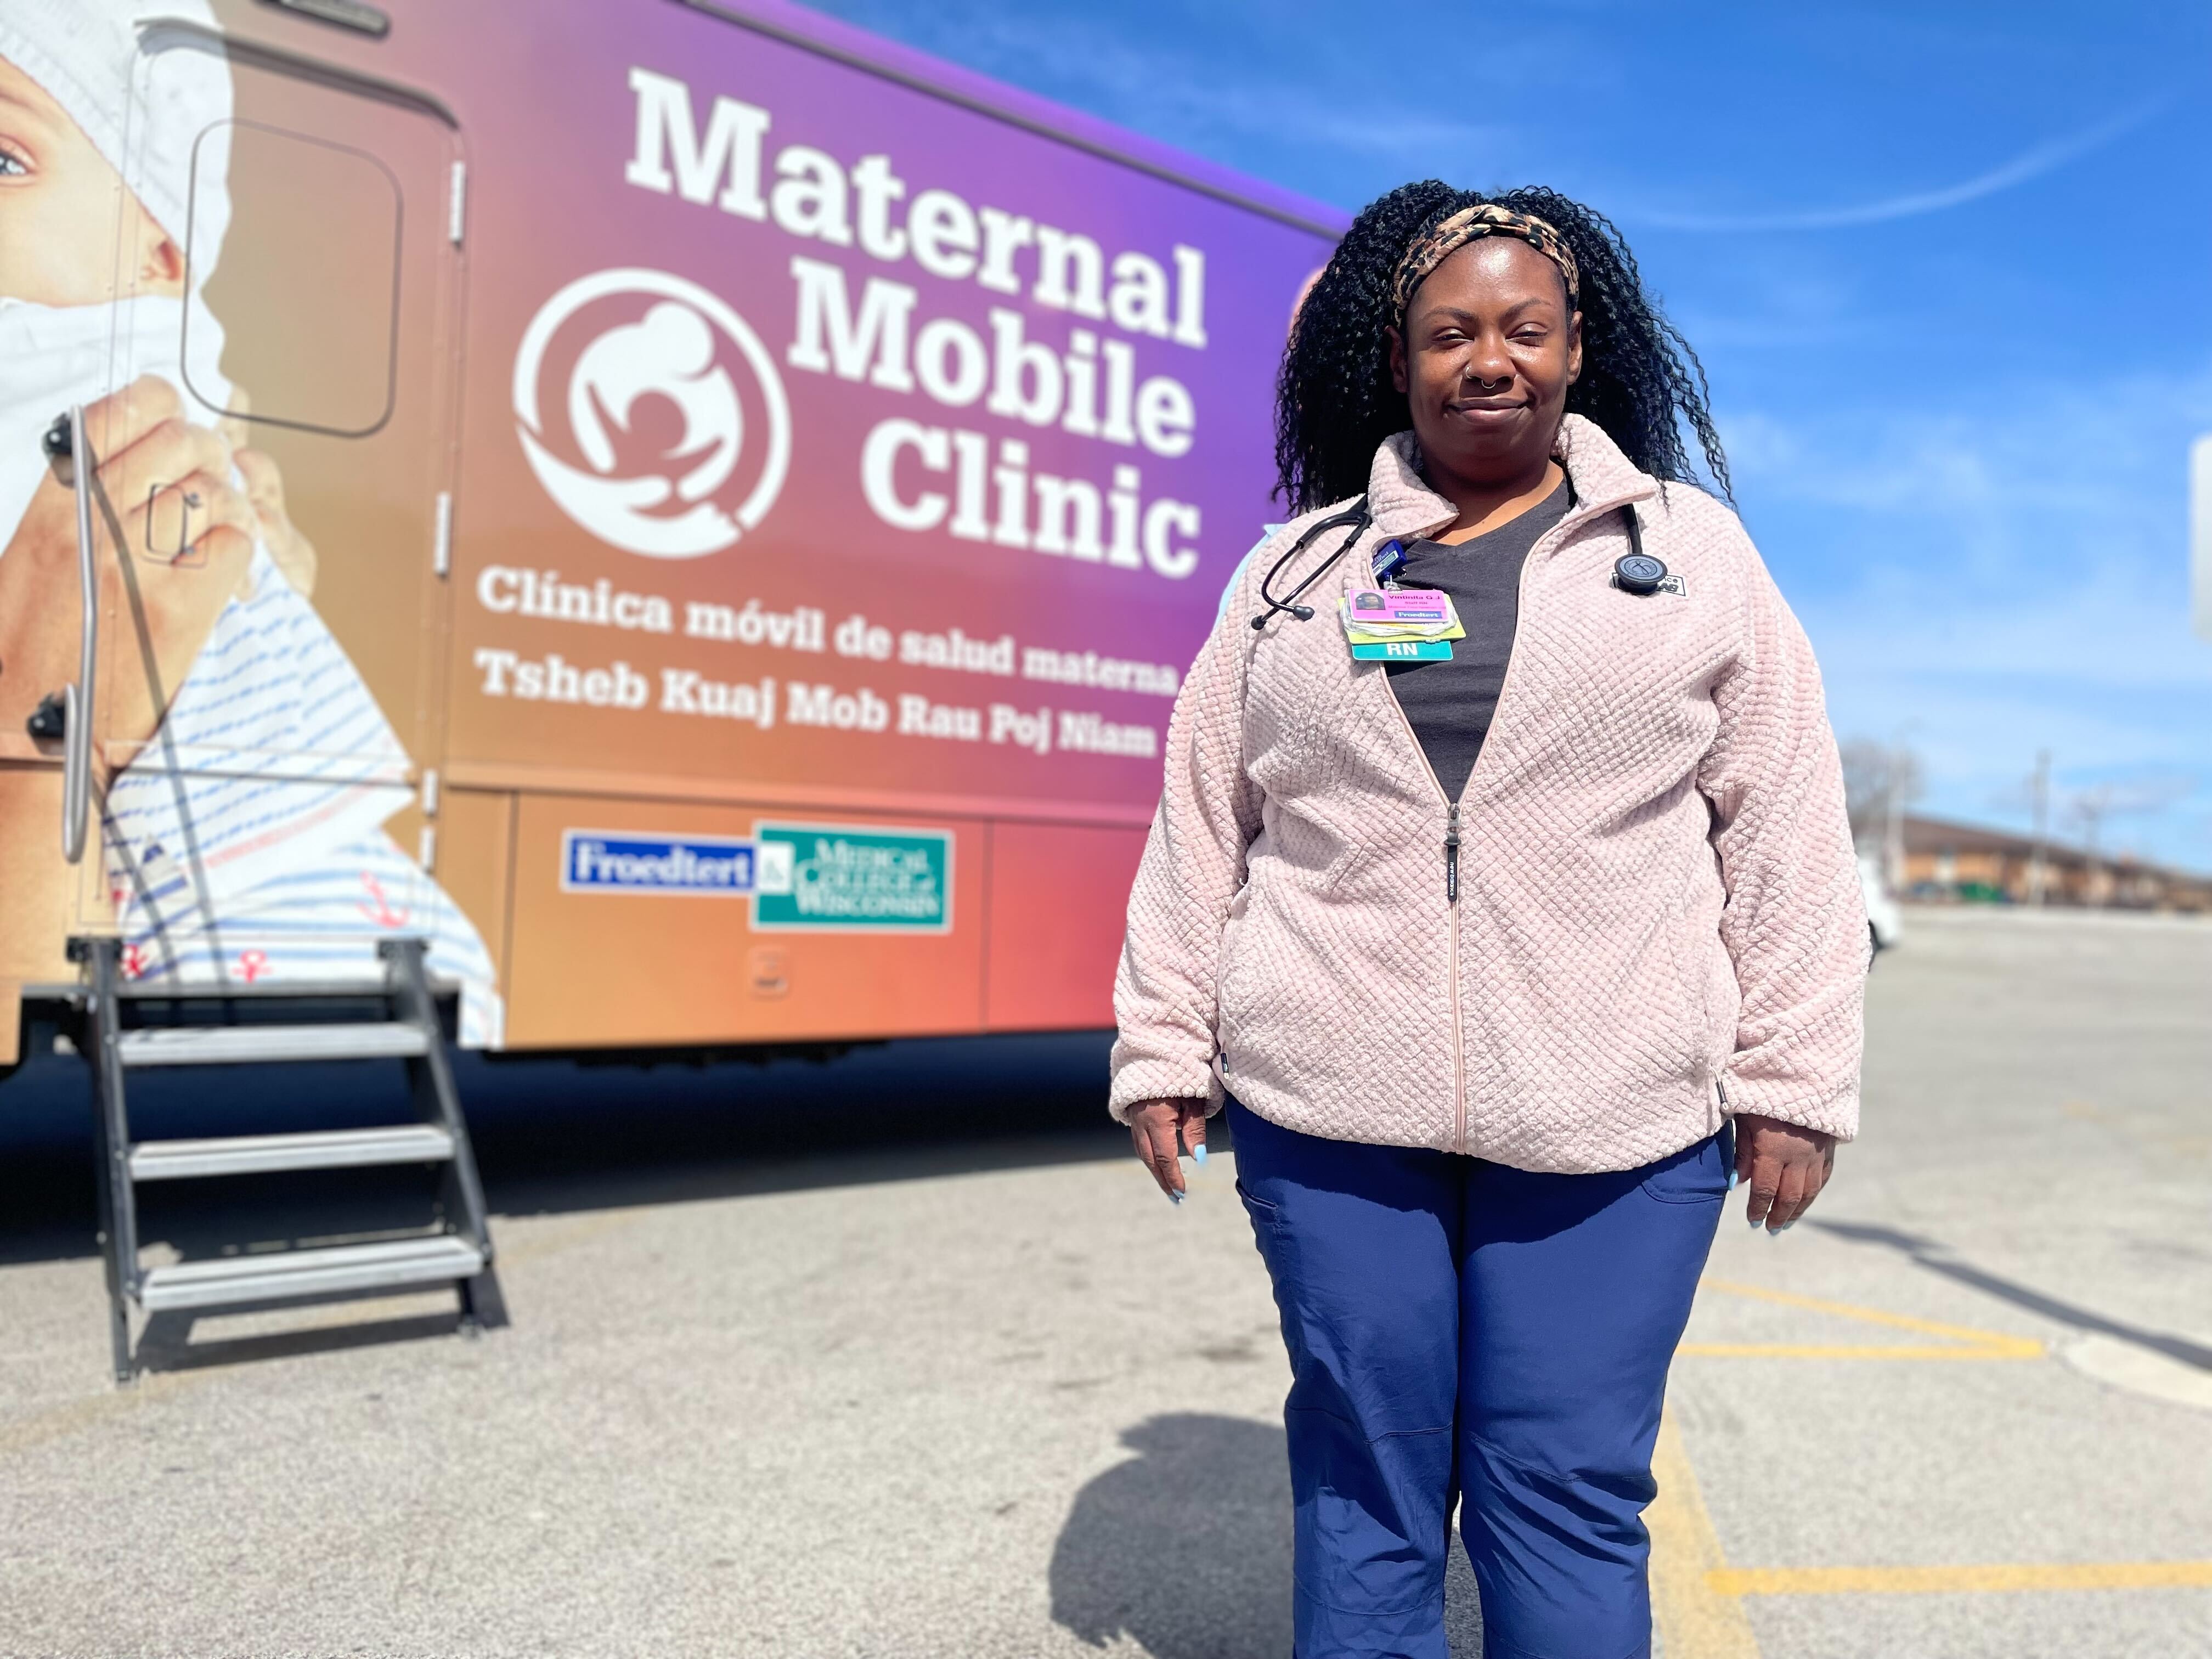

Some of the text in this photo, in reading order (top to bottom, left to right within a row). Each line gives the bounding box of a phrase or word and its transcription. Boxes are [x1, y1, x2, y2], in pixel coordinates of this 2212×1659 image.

[625, 66, 1206, 349] Maternal
[788, 255, 1194, 457] Mobile
[861, 416, 1200, 579] Clinic
[477, 565, 1180, 696] Clínica móvil de salud materna
[1386, 643, 1418, 656] RN
[474, 647, 1158, 758] Tsheb Kuaj Mob Rau Poj Niam
[575, 840, 751, 885] Froedtert
